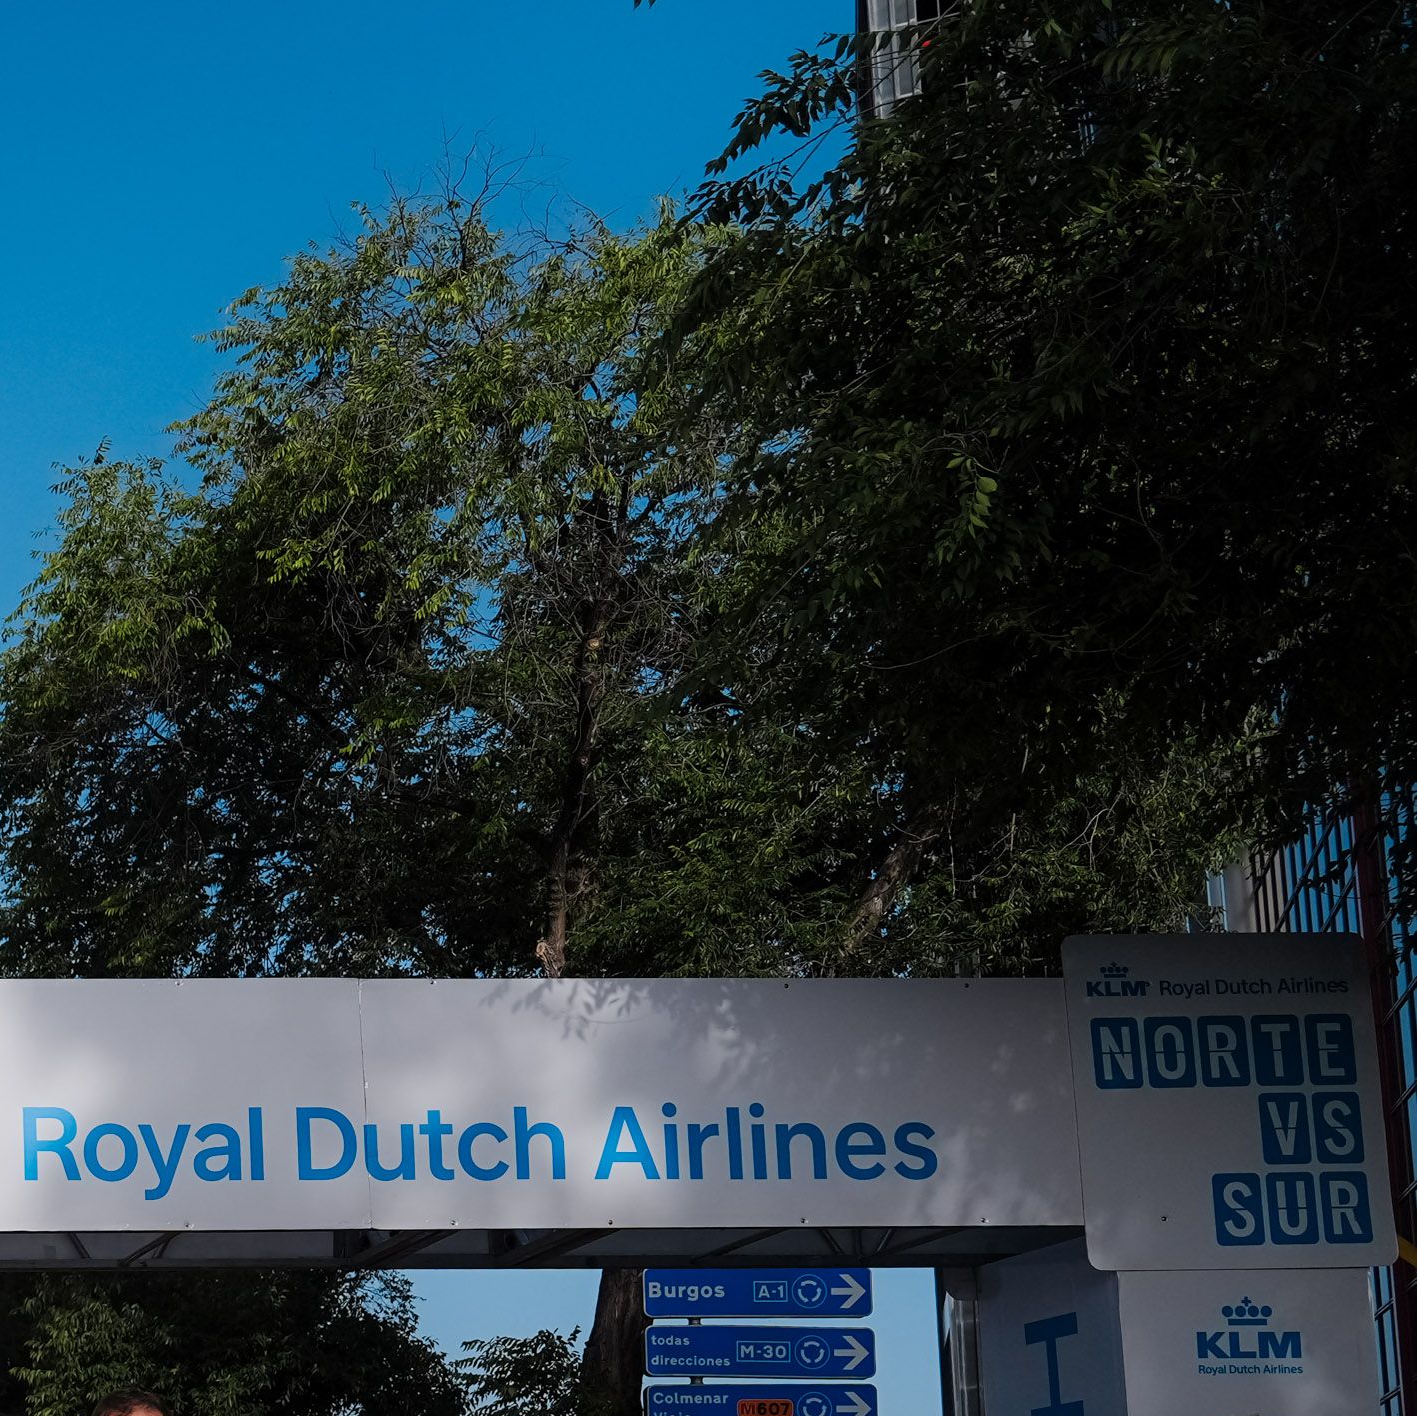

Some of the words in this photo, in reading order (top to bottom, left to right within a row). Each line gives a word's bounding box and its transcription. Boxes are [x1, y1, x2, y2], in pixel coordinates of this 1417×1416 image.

[1086, 980, 1147, 998] KLM
[1159, 979, 1211, 999] Royal
[1215, 978, 1272, 996] Dutch
[1277, 976, 1349, 994] Airlines
[1099, 1022, 1346, 1081] NORTE
[1267, 1099, 1356, 1156] VS
[23, 1106, 265, 1201] Royal
[295, 1105, 567, 1182] Dutch
[595, 1102, 939, 1181] Airlines
[1222, 1179, 1363, 1238] SUR
[647, 1281, 725, 1302] Burgos
[758, 1285, 786, 1299] A-1
[651, 1334, 690, 1346] todas
[1195, 1331, 1303, 1359] KLM
[651, 1355, 731, 1367] direcciones
[740, 1345, 787, 1359] M-30
[1198, 1364, 1227, 1377] Royal
[1229, 1364, 1261, 1375] Dutch
[1263, 1364, 1303, 1375] Airlines
[653, 1391, 729, 1405] Colmenar
[740, 1402, 790, 1416] M607
